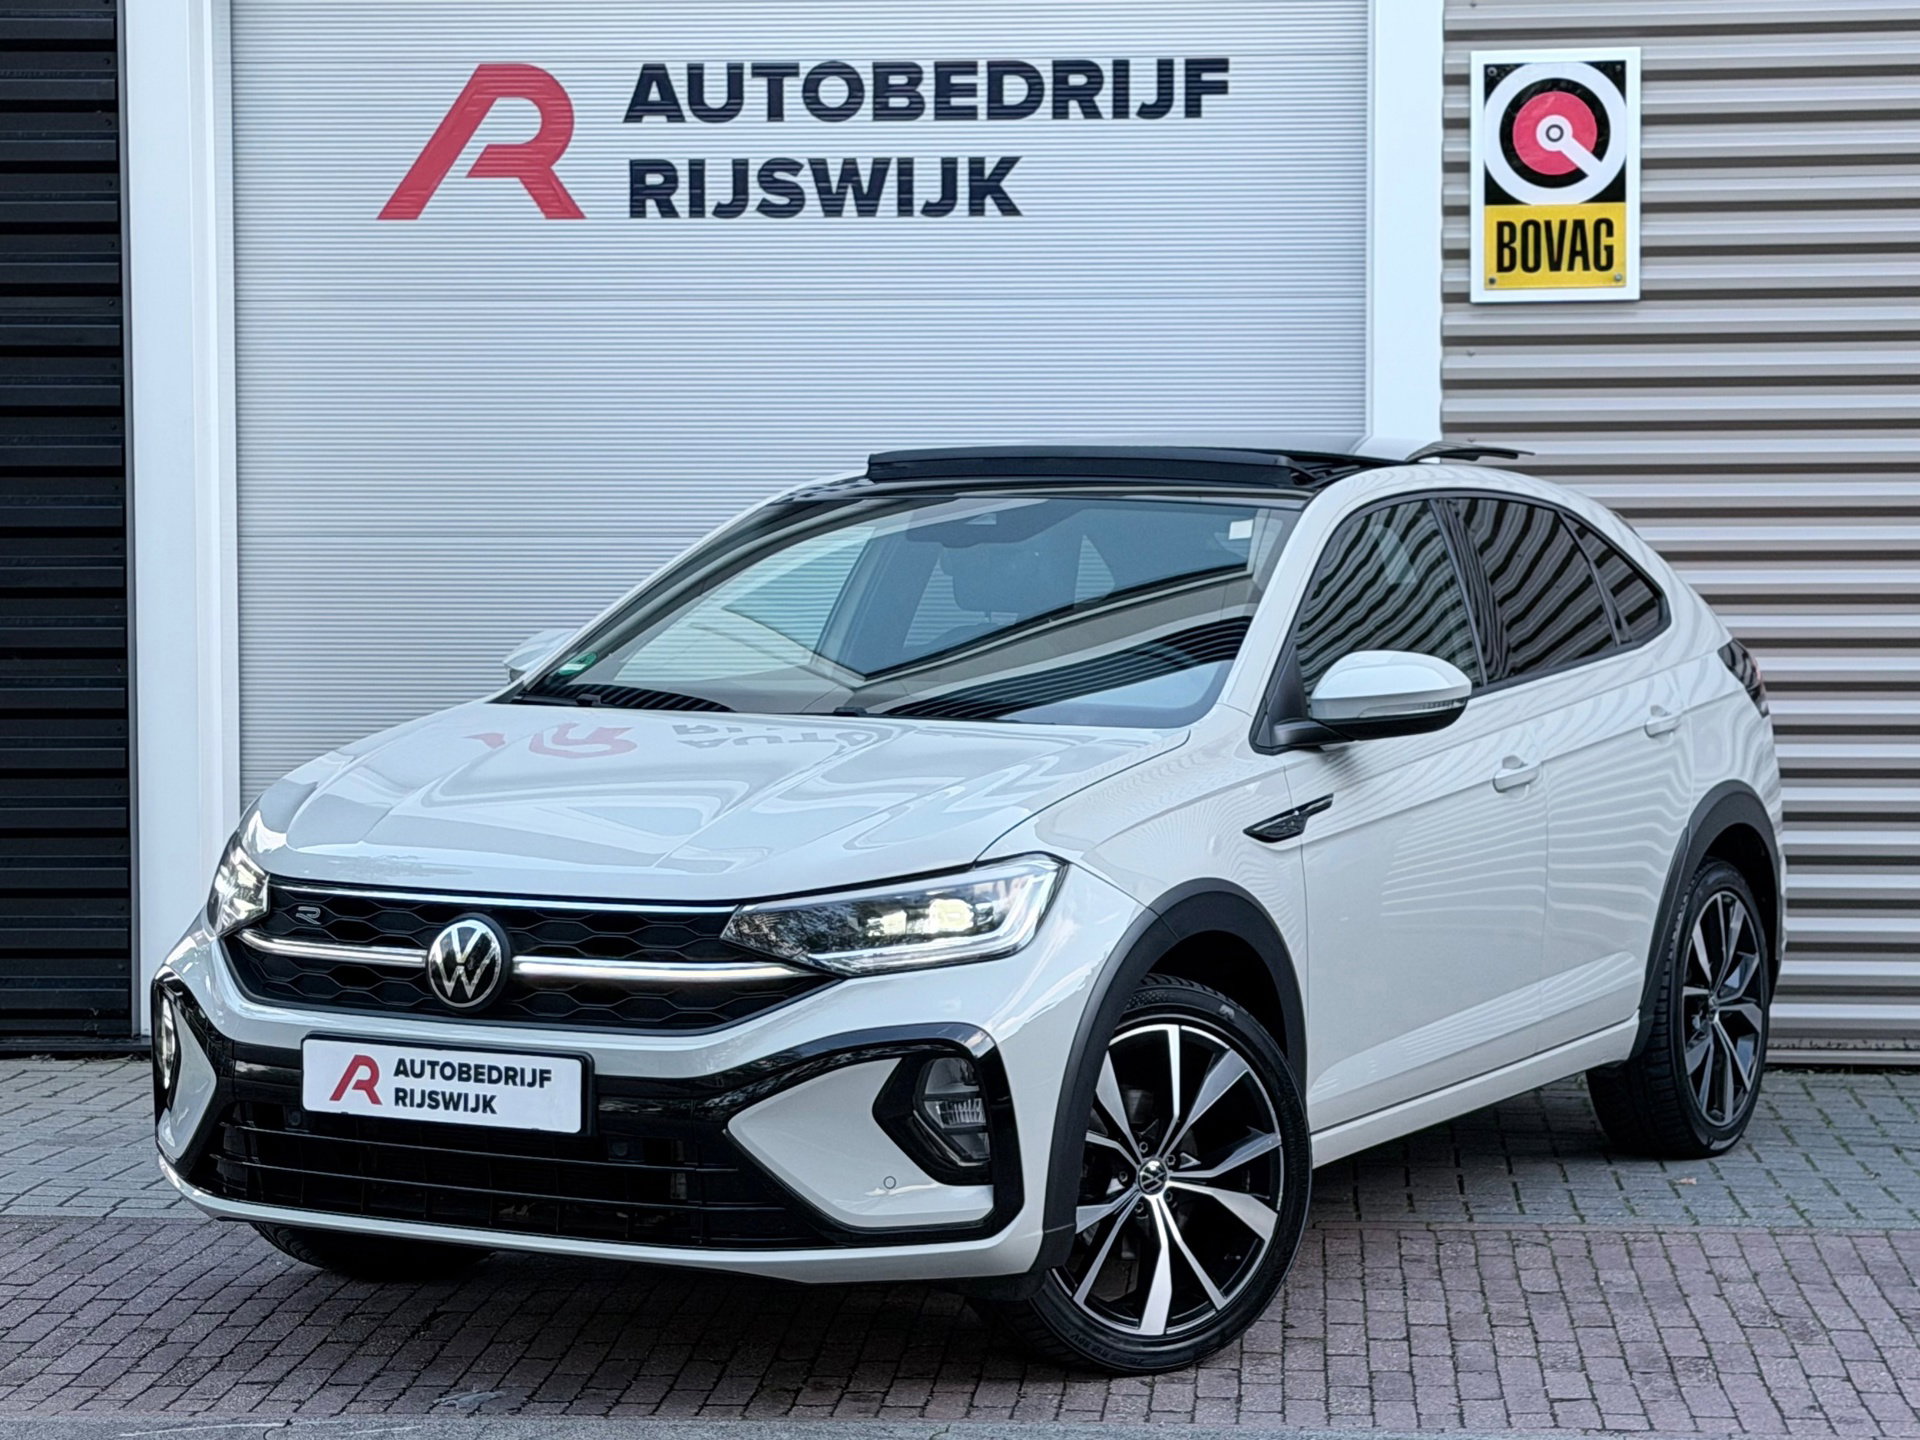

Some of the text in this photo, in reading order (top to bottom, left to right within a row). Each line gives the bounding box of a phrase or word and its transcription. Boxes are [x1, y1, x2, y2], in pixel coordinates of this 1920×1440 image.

[623, 58, 1230, 124] AUTOBEDRIJF
[629, 156, 1021, 219] RIJSWIJK
[1496, 218, 1614, 273] BOVAG
[393, 1058, 552, 1088] AUTOBEDRIJF
[394, 1087, 497, 1114] RIJSWIJK
